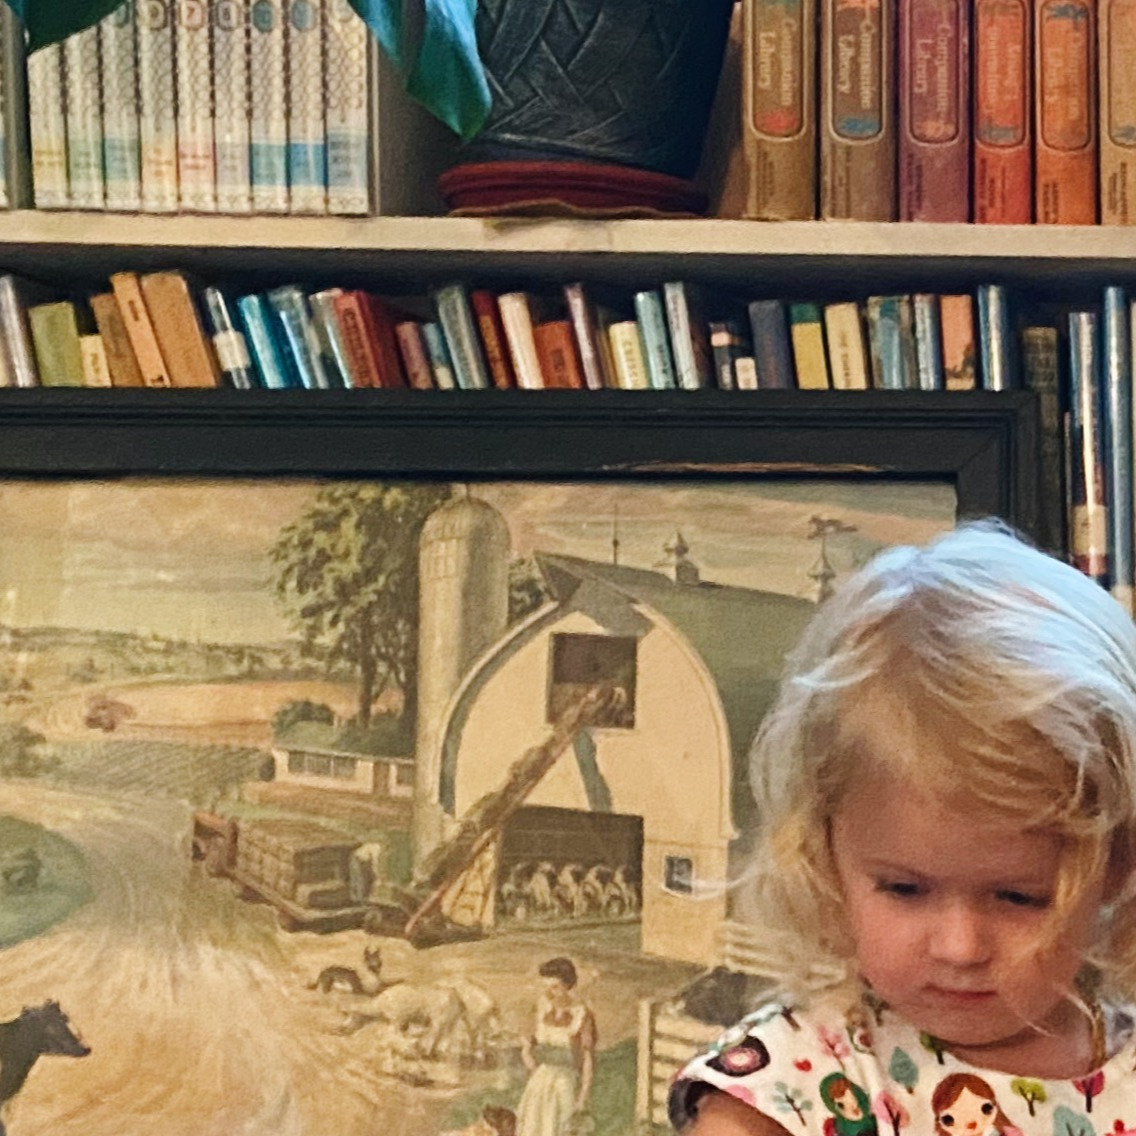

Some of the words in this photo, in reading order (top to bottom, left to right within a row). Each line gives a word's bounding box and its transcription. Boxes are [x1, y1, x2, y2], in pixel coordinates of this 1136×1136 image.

[837, 35, 854, 94] Library
[860, 20, 875, 109] Companion
[914, 38, 932, 93] Library
[935, 24, 952, 113] Companion
